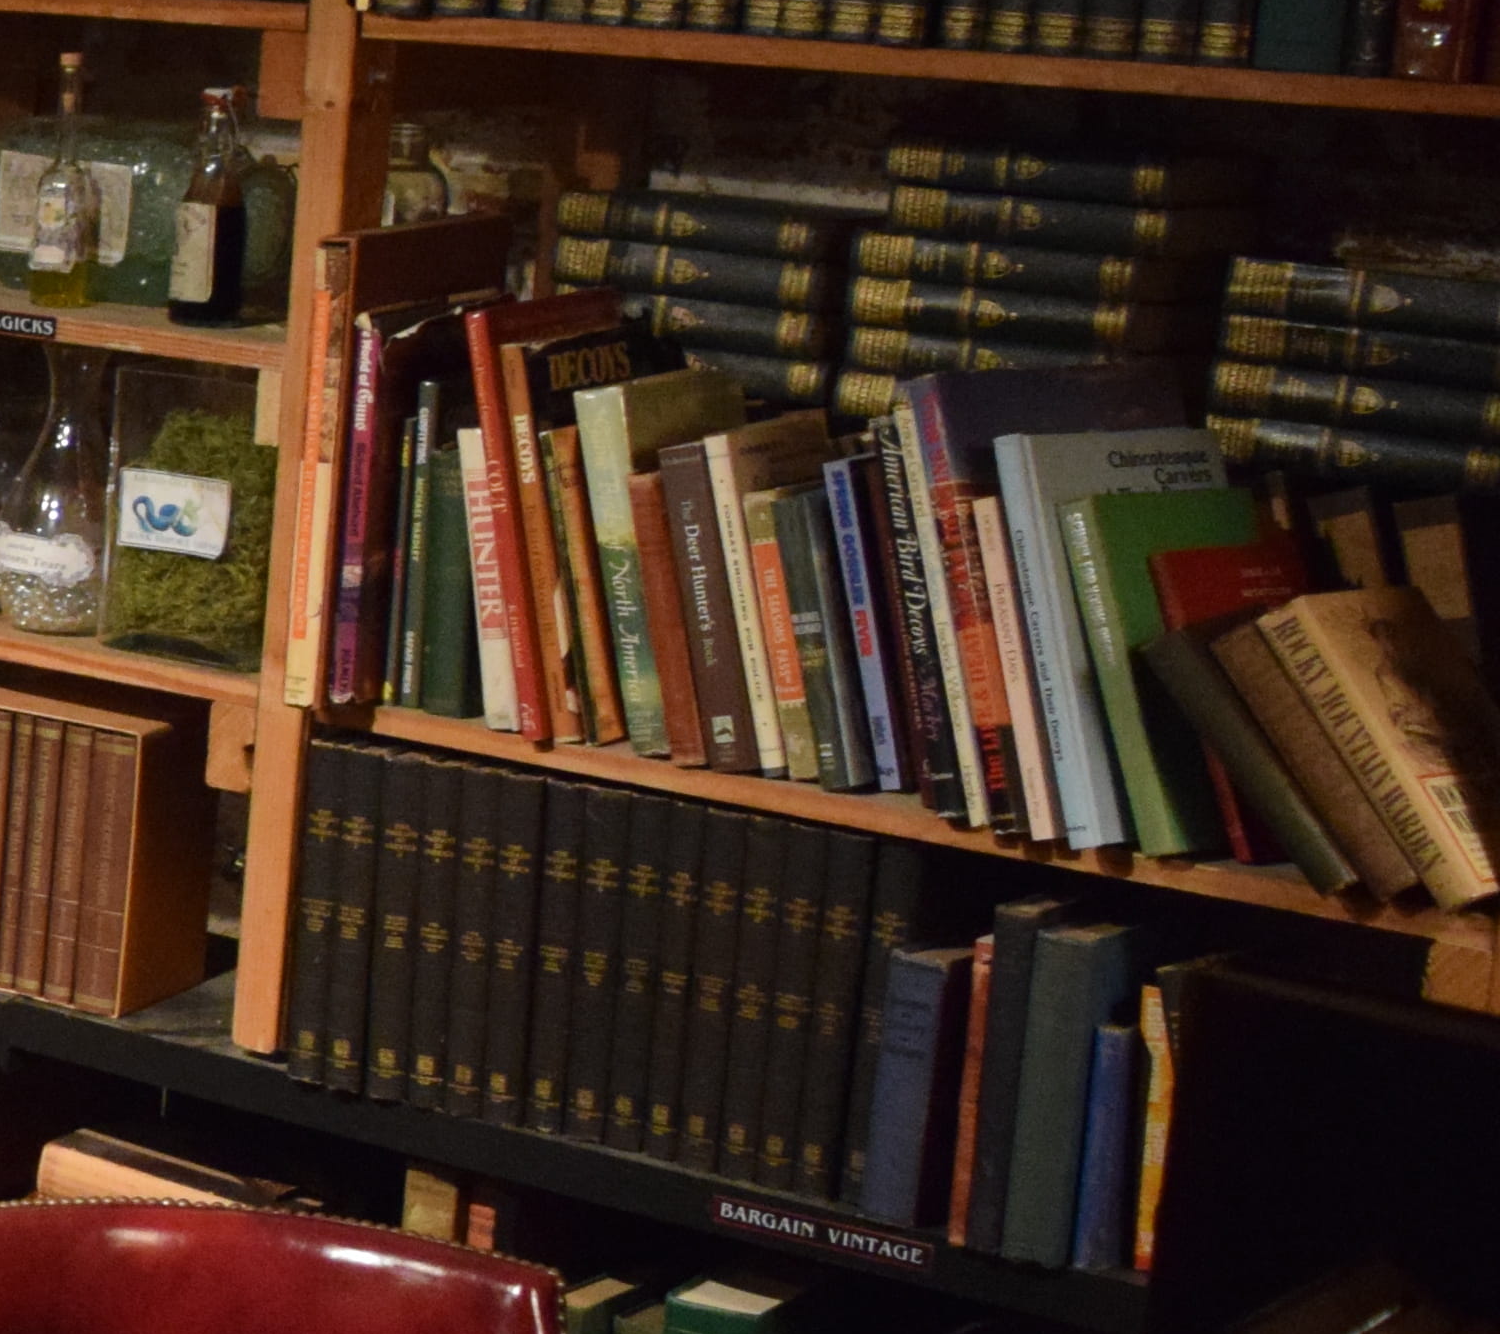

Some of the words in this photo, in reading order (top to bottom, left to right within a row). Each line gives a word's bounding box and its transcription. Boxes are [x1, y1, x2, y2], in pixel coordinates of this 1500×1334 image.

[549, 341, 631, 393] DECOYS
[513, 413, 537, 484] DECOYS
[878, 427, 915, 531] American
[1108, 450, 1211, 472] Chincoteague
[680, 499, 696, 520] The
[831, 470, 854, 529] SPRING
[467, 489, 505, 618] HUNTER
[683, 523, 704, 561] Deer
[841, 533, 866, 606] GOBBLER
[894, 534, 925, 583] Bird
[607, 560, 632, 616] North
[690, 565, 717, 631] Hunter's
[703, 636, 717, 666] Book
[853, 609, 873, 657] FEVER
[899, 585, 932, 657] Decoys
[617, 622, 647, 702] America
[1271, 616, 1331, 689] ROCKY
[1313, 689, 1394, 790] MOUNTAIN
[1378, 790, 1448, 875] WARDEN
[718, 1200, 816, 1240] BARGAIN
[827, 1227, 925, 1265] VINTAGE
